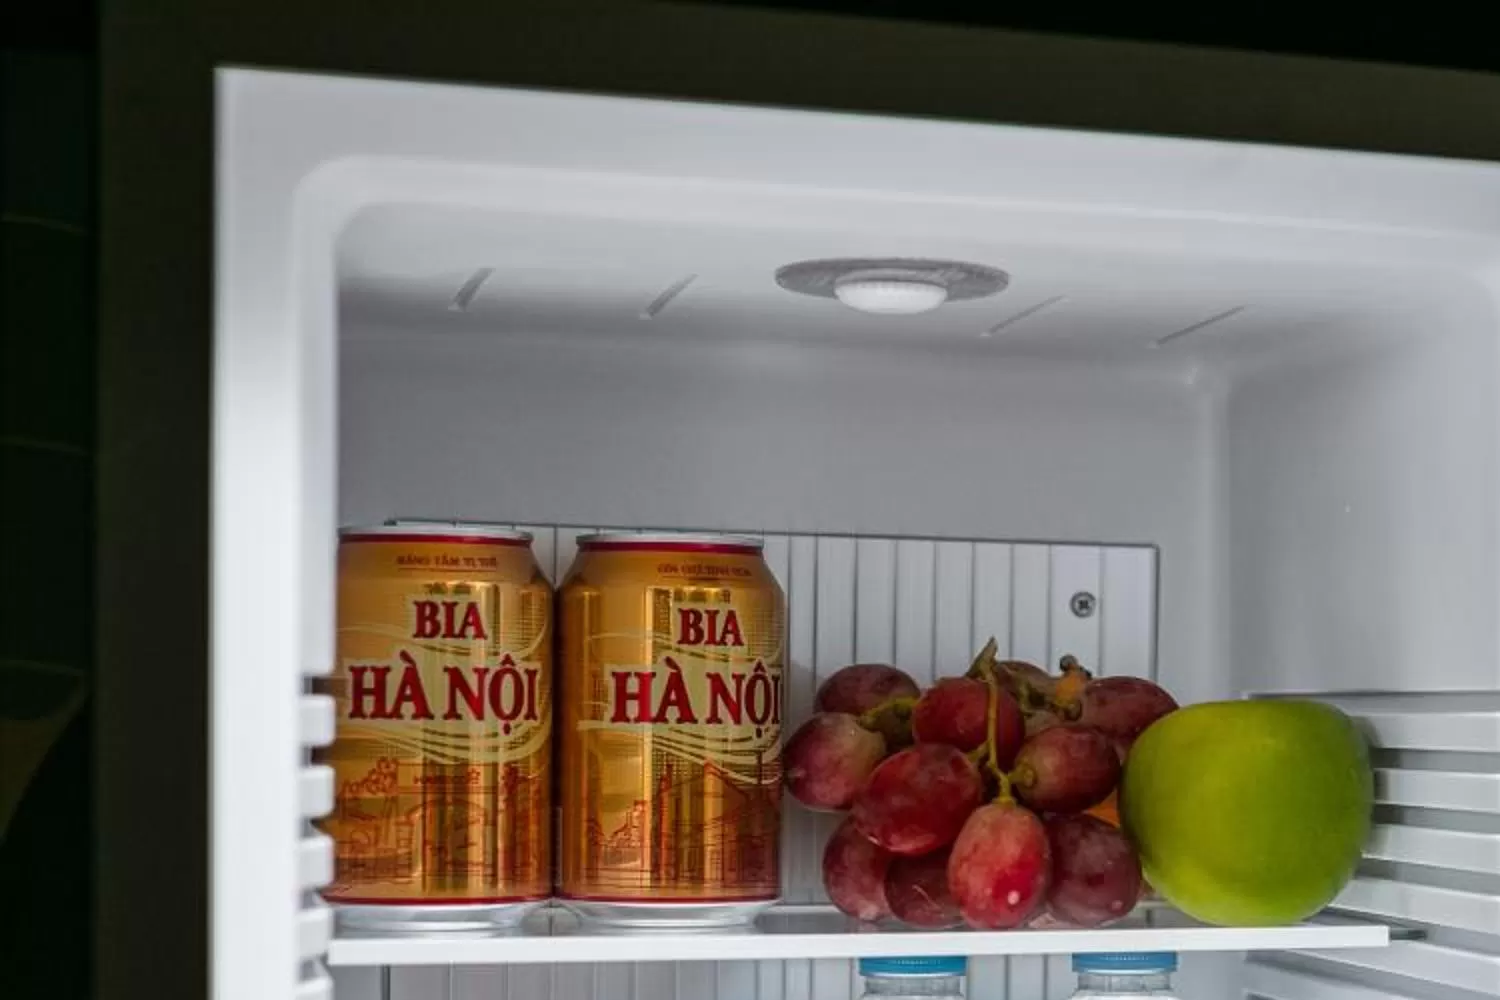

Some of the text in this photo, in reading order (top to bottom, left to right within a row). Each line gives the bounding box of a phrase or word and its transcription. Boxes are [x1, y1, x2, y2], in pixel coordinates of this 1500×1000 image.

[413, 601, 488, 640] BIA
[677, 608, 745, 647] BIA
[348, 650, 539, 735] HÀ NỘI
[611, 656, 781, 739] HÀ NỘI
